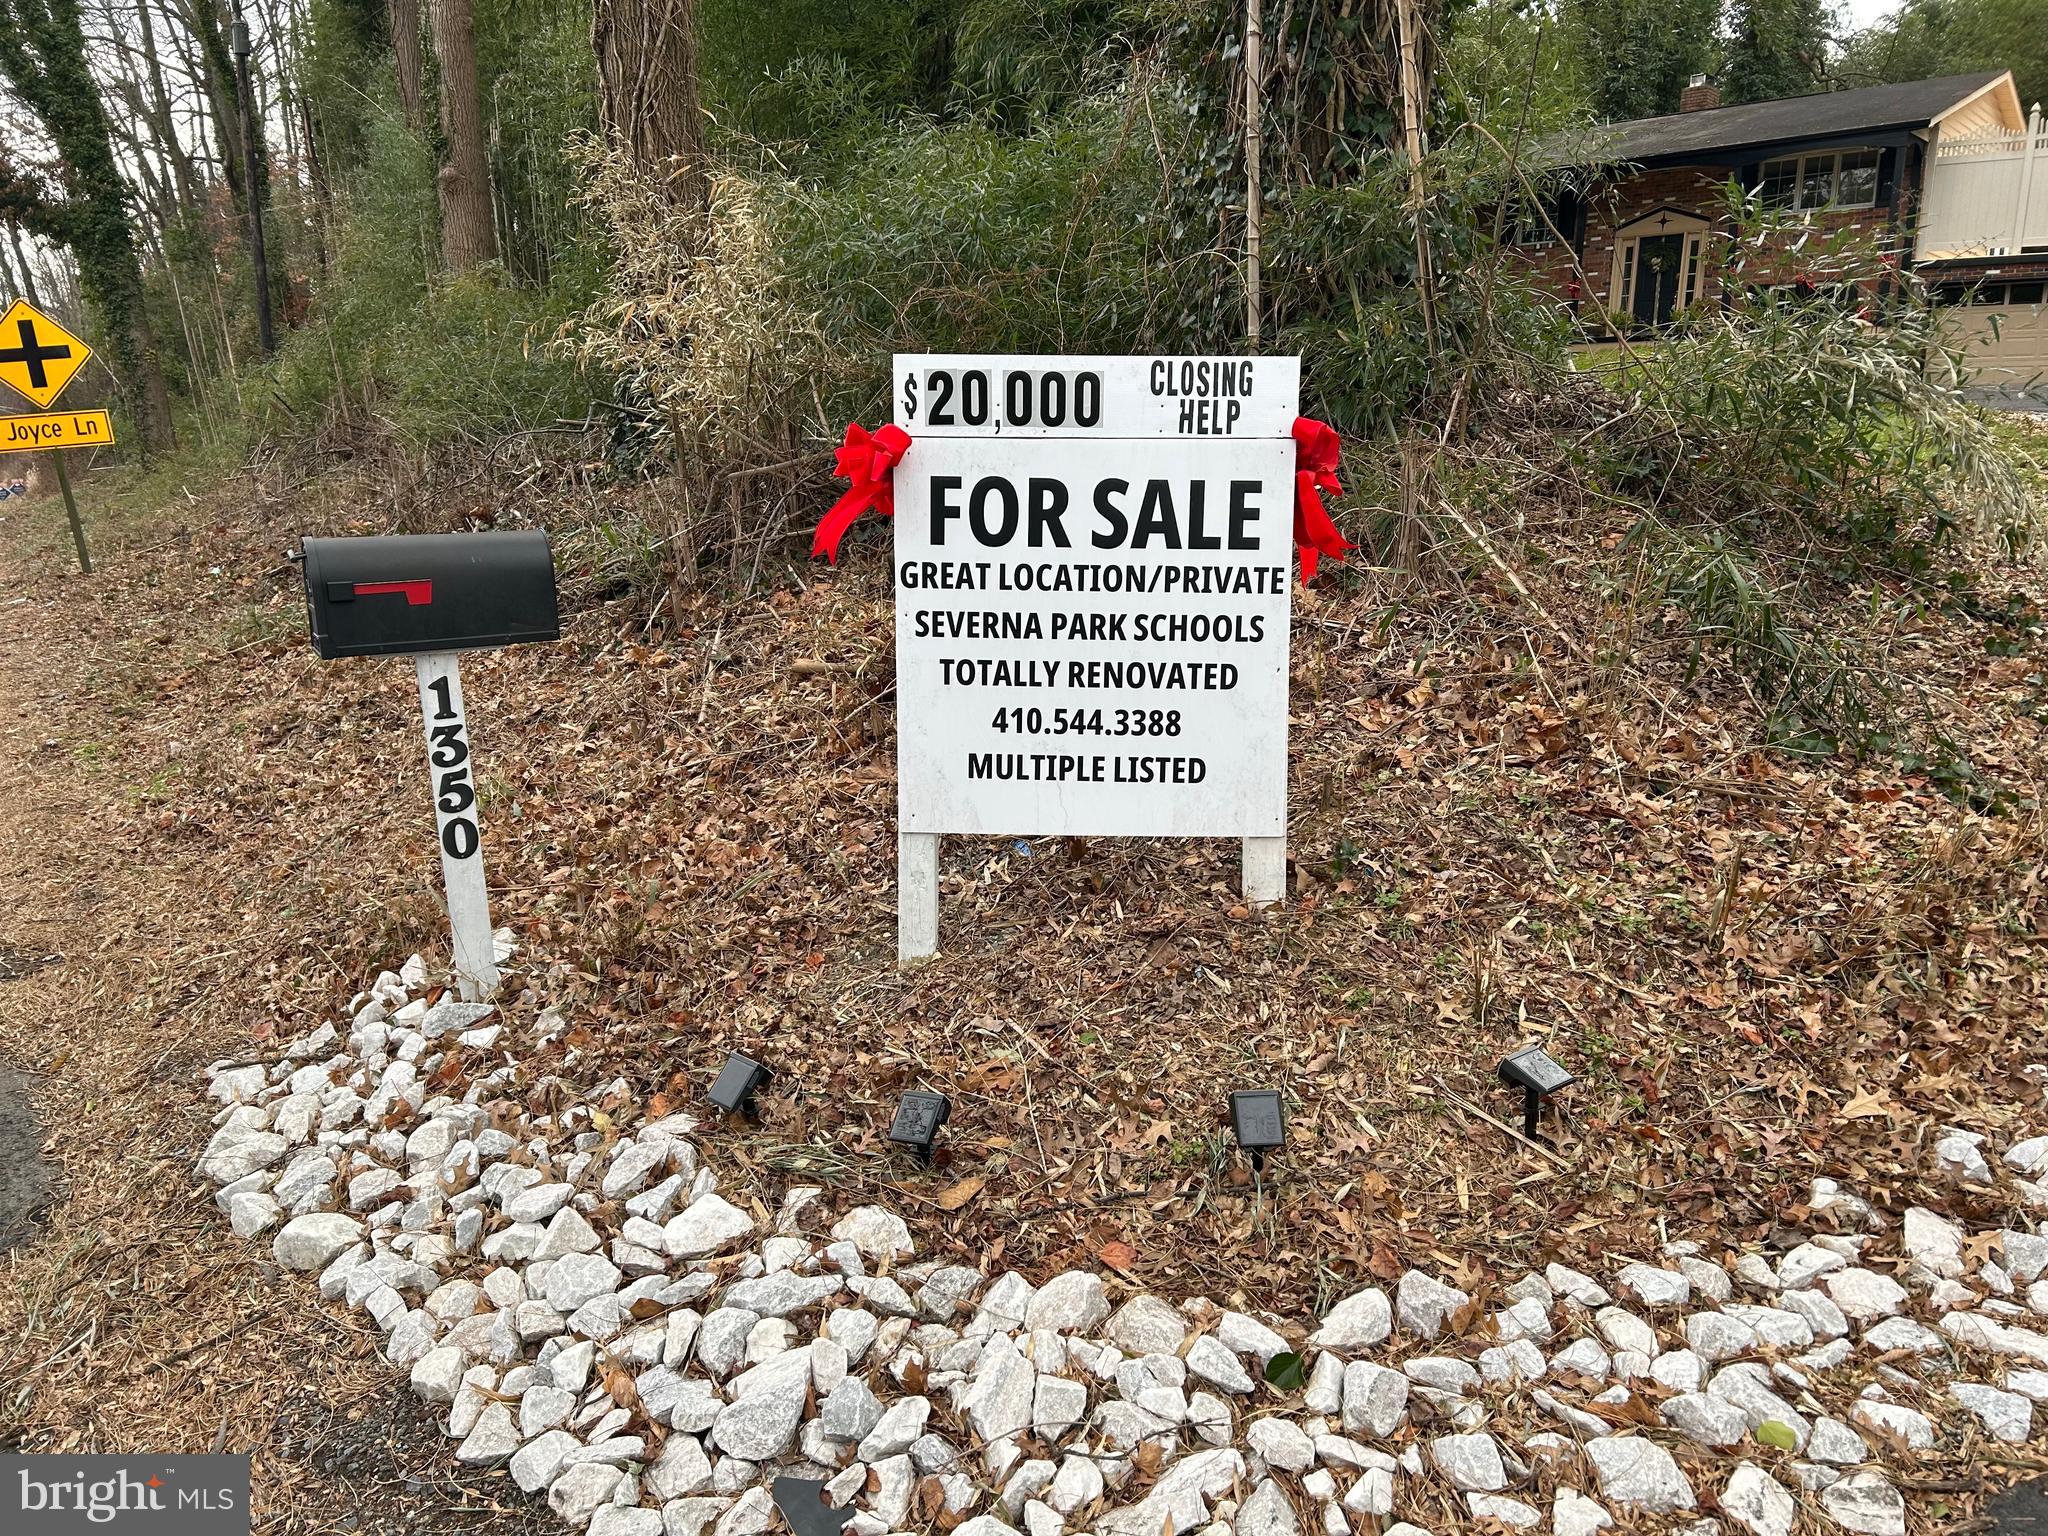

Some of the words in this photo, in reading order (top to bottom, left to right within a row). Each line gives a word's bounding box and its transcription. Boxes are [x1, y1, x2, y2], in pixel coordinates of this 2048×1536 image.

[1151, 359, 1254, 397] CLOSING
[904, 370, 1103, 434] $20,000
[1178, 399, 1241, 435] HELP
[8, 422, 62, 444] Joyce
[74, 417, 98, 435] Ln
[929, 475, 1072, 548] FOR
[1091, 478, 1263, 550] SALE
[900, 561, 991, 590] GREAT
[999, 563, 1285, 595] LOCATION/PRIVATE
[915, 610, 1043, 639] SEVERNA
[1051, 613, 1127, 641] PARK
[1133, 614, 1265, 643] SCHOOLS
[940, 658, 1060, 687] TOTALLY
[1068, 661, 1239, 690] RENOVATED
[992, 707, 1182, 737] 410.544.3388
[427, 675, 479, 860] 1350
[968, 753, 1105, 782] MULTIPLE
[1114, 756, 1206, 784] LISTED
